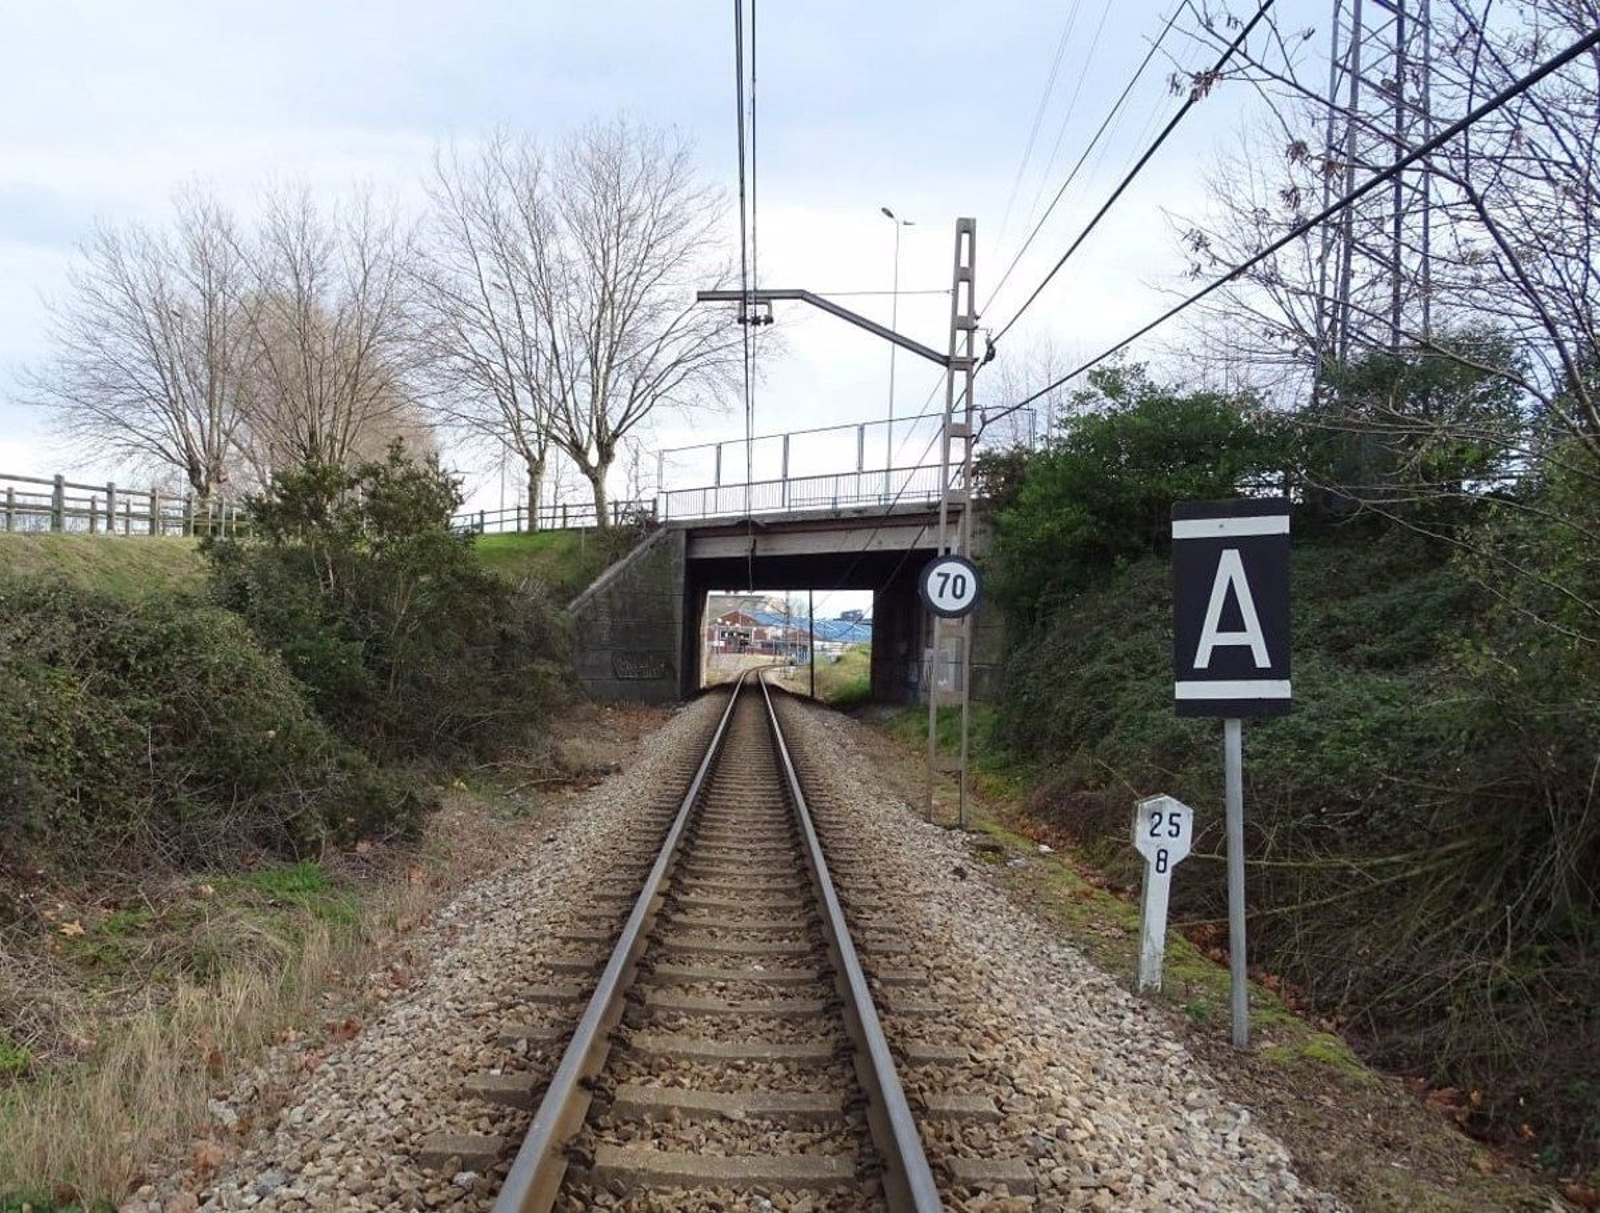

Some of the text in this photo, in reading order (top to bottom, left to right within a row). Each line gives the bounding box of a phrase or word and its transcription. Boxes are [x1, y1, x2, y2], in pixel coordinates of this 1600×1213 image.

[937, 572, 967, 600] 70
[1193, 549, 1272, 668] A
[1149, 812, 1182, 838] 25
[1156, 848, 1169, 874] 8
